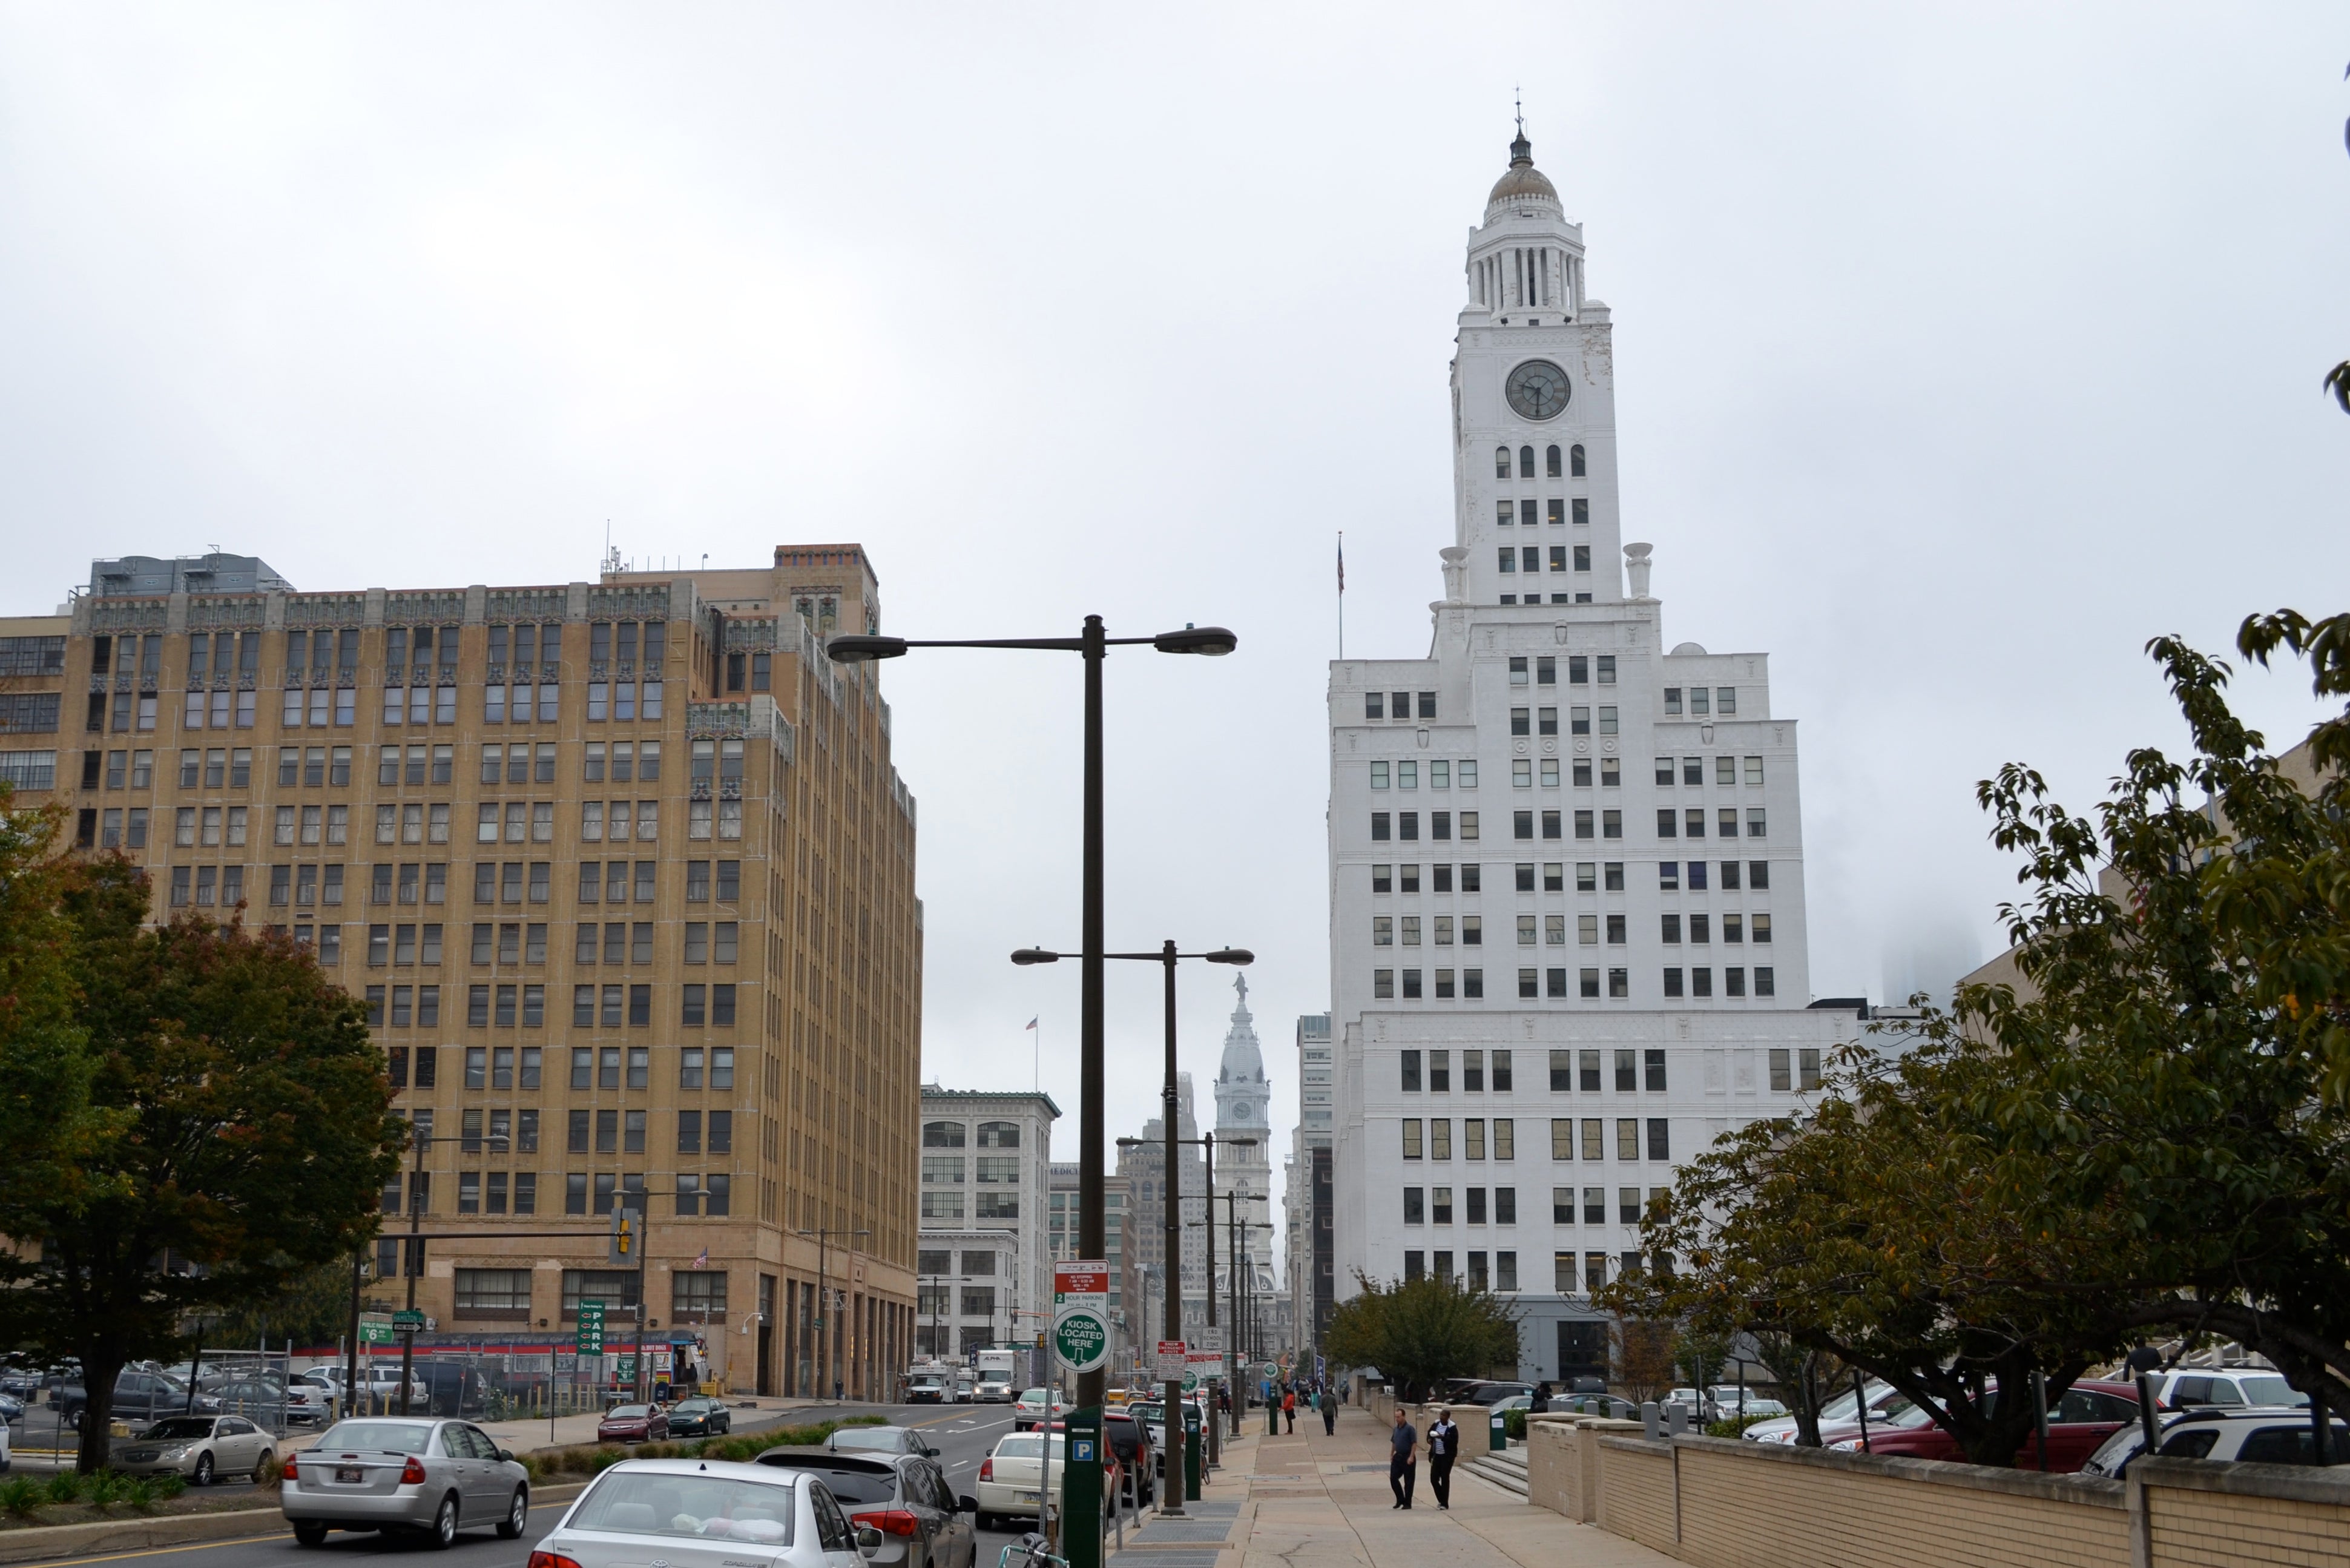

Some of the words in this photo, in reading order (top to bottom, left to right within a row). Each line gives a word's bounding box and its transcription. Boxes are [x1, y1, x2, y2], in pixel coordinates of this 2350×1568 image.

[1057, 1294, 1063, 1302] 2
[1067, 1320, 1097, 1331] KIOSK
[591, 1312, 602, 1351] PARK
[1059, 1328, 1103, 1340] LOCATED
[1067, 1338, 1093, 1348] HERE
